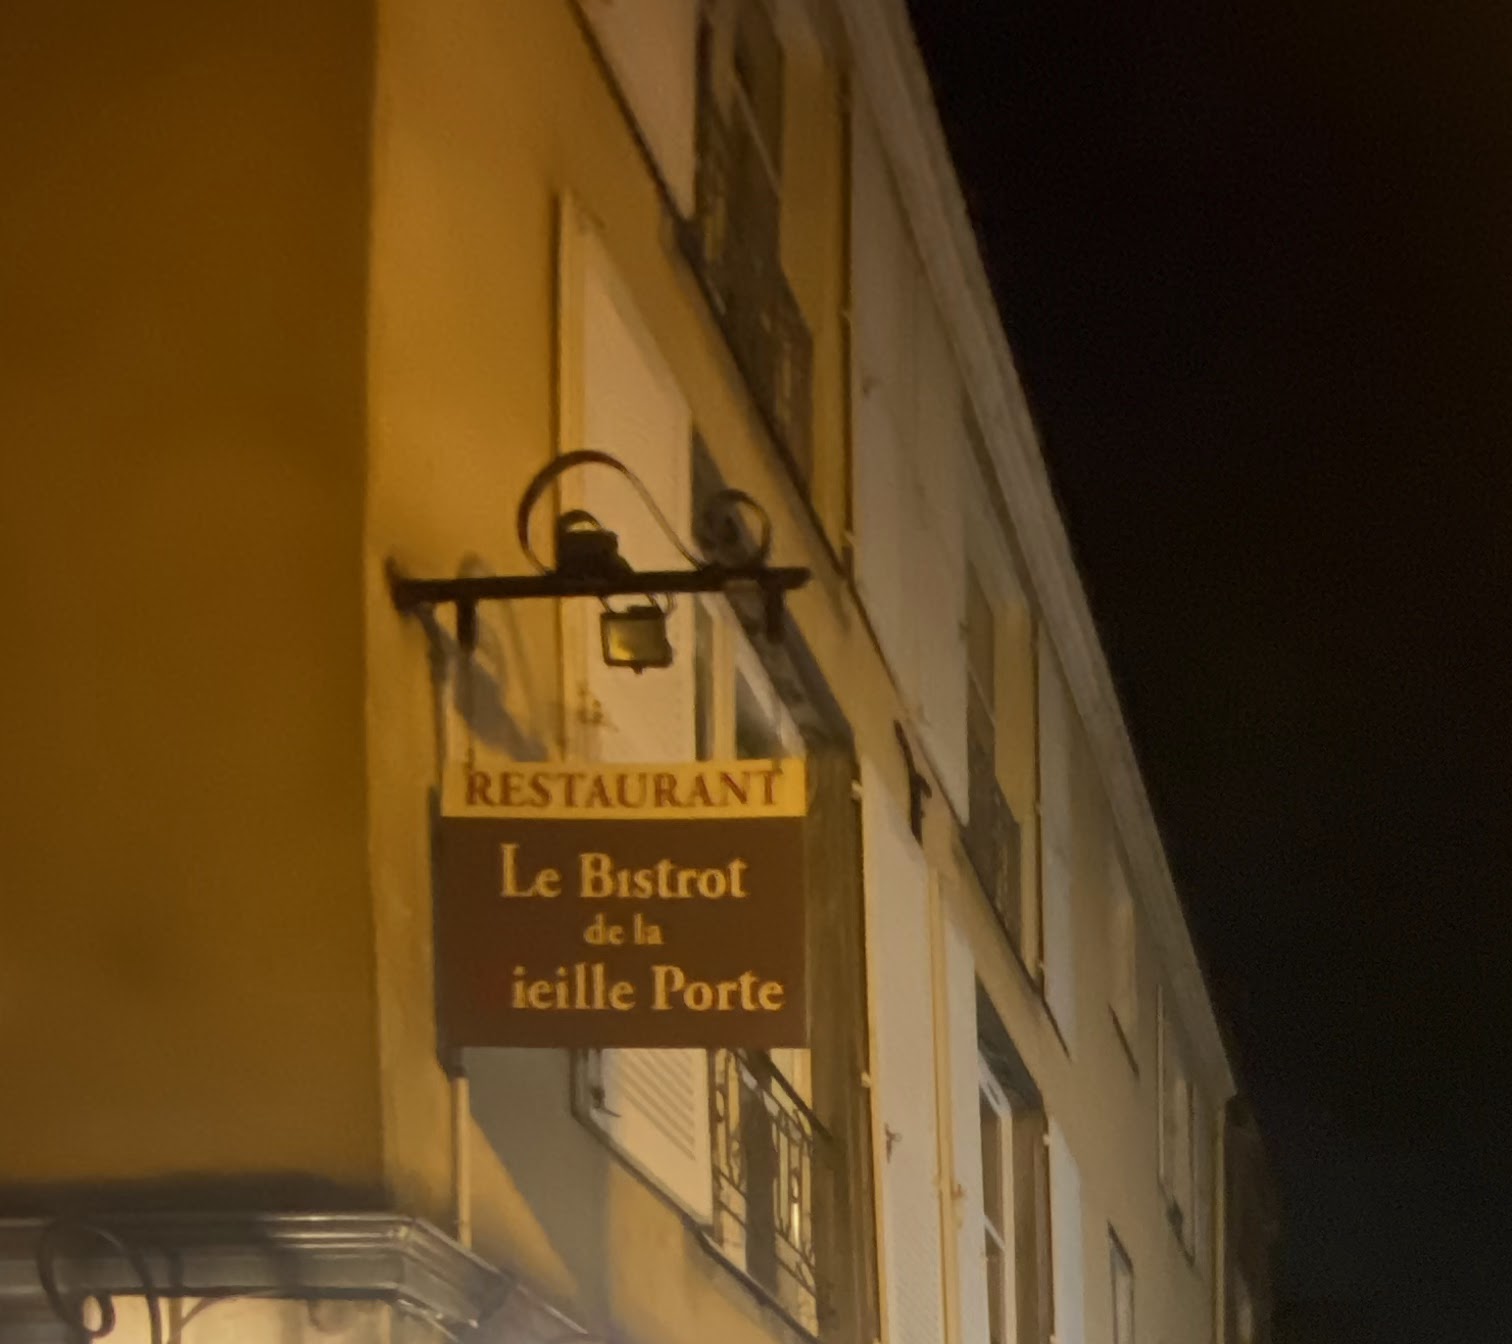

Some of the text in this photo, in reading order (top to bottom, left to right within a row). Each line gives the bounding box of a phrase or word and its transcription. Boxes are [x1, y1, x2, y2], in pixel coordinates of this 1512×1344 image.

[466, 767, 783, 809] RESTAURANT
[501, 843, 749, 899] Le Bistrot
[583, 913, 664, 946] de la
[651, 964, 784, 1012] Porte
